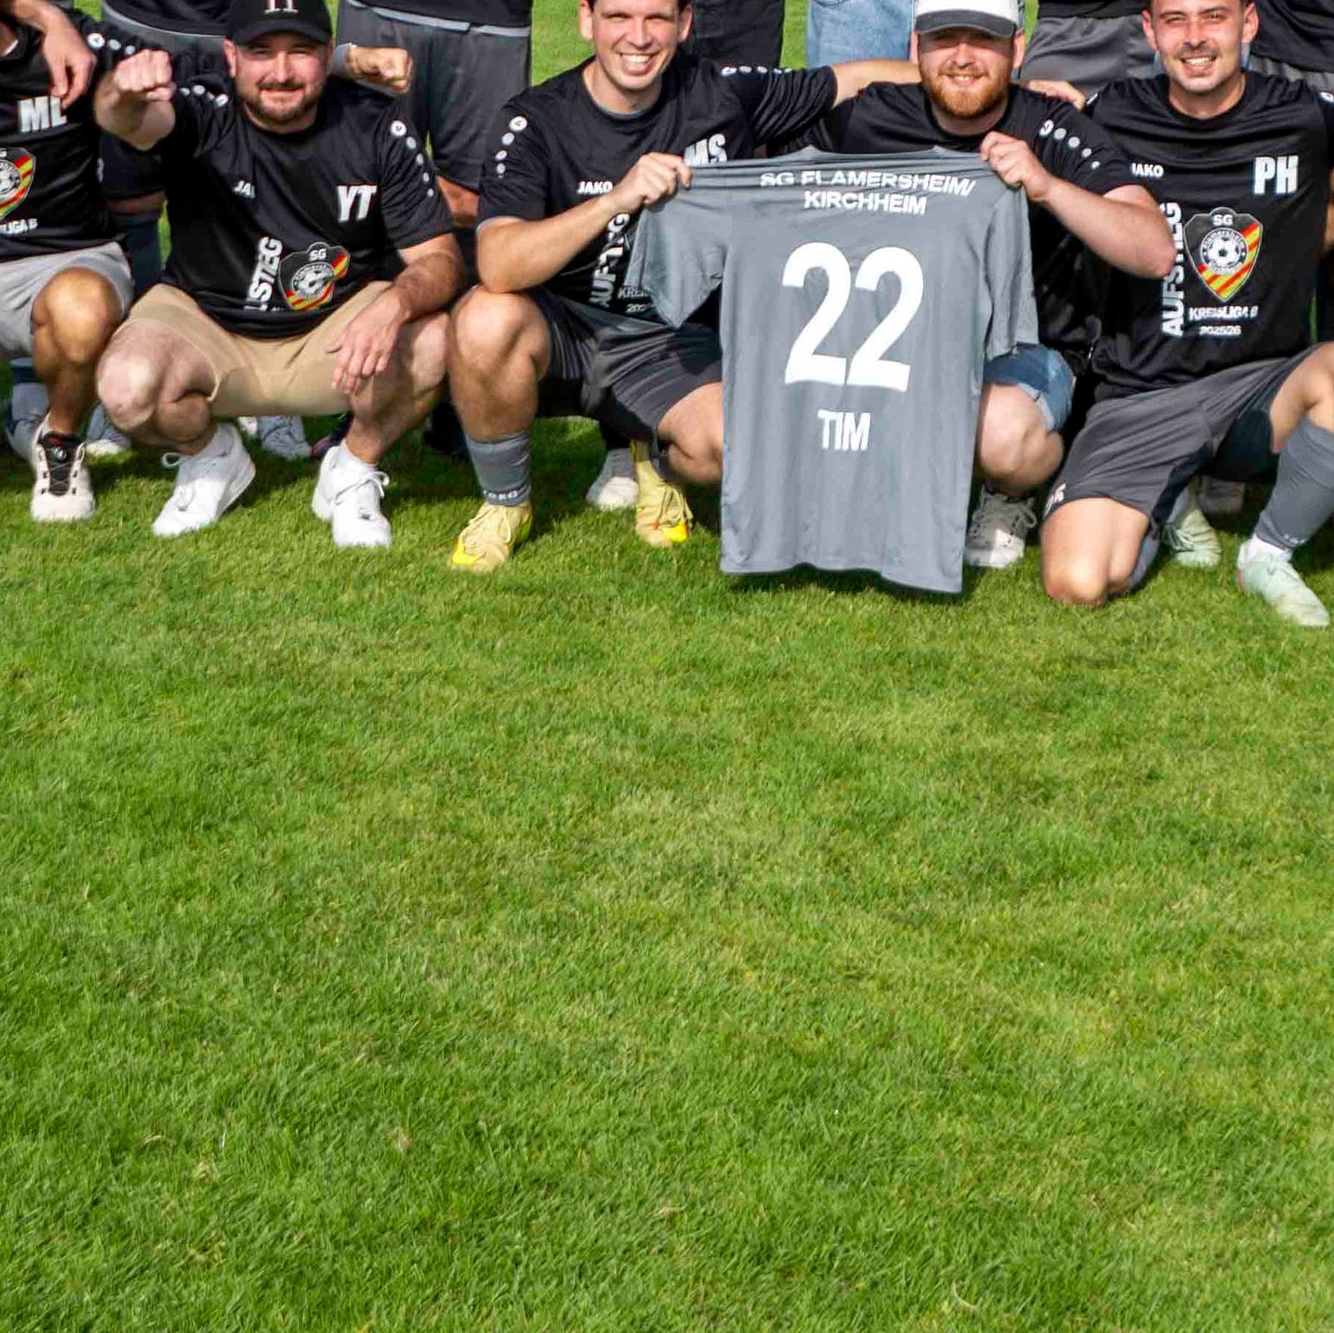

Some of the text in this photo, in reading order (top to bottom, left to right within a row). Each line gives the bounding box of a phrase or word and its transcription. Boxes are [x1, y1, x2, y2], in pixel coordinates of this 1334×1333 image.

[684, 133, 727, 165] MS
[760, 172, 794, 187] SG
[1254, 155, 1299, 195] PH
[234, 180, 255, 199] JA
[578, 181, 613, 194] JAKO
[337, 185, 377, 222] YT
[803, 191, 927, 215] KIRCHHEIM
[1213, 214, 1233, 225] SG
[309, 249, 327, 261] SG
[781, 241, 924, 393] 22
[817, 409, 871, 451] TIM
